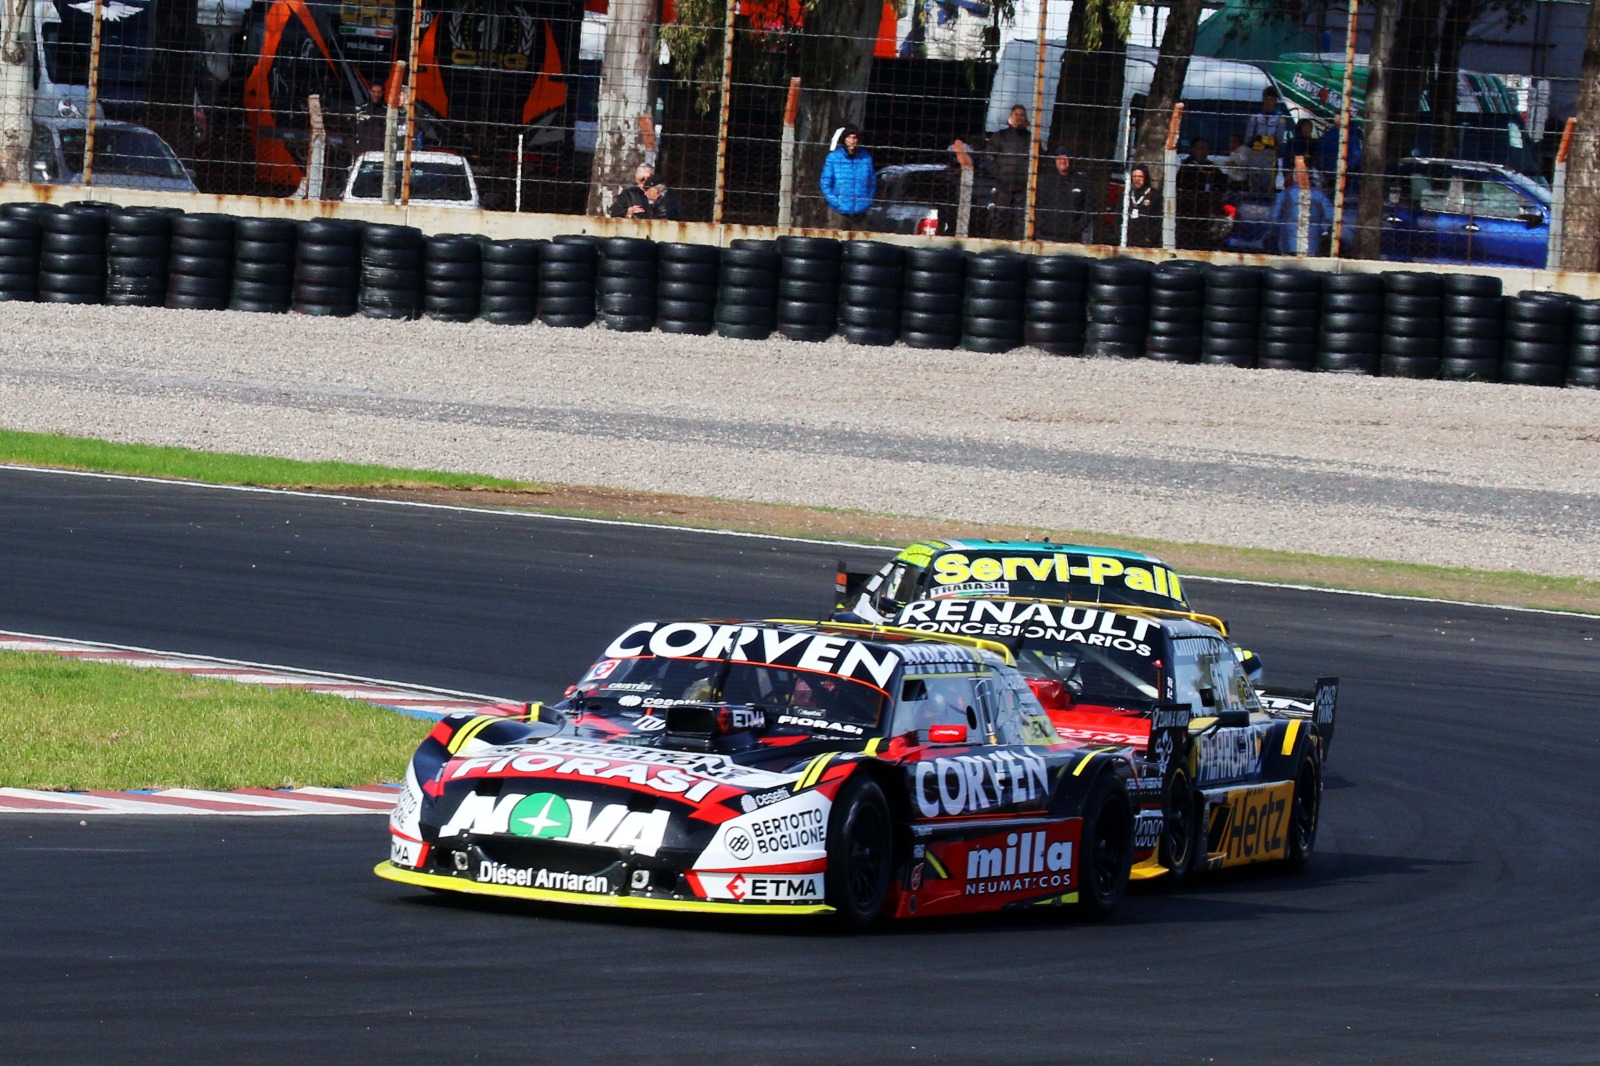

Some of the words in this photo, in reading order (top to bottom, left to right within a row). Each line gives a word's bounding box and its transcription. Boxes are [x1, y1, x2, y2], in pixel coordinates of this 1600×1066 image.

[899, 600, 1161, 643] RENAULT
[605, 622, 899, 689] CORVEN
[778, 715, 864, 735] FIORASI
[451, 752, 718, 803] FIORASI
[916, 747, 1050, 818] CORVEN
[438, 790, 671, 857] NOVA
[752, 808, 823, 838] BERTOTTO
[757, 826, 825, 854] BOGLIONE
[1227, 790, 1287, 860] Hertz
[479, 860, 534, 887] Diésel
[967, 831, 1073, 879] milla
[752, 879, 816, 897] ETMA
